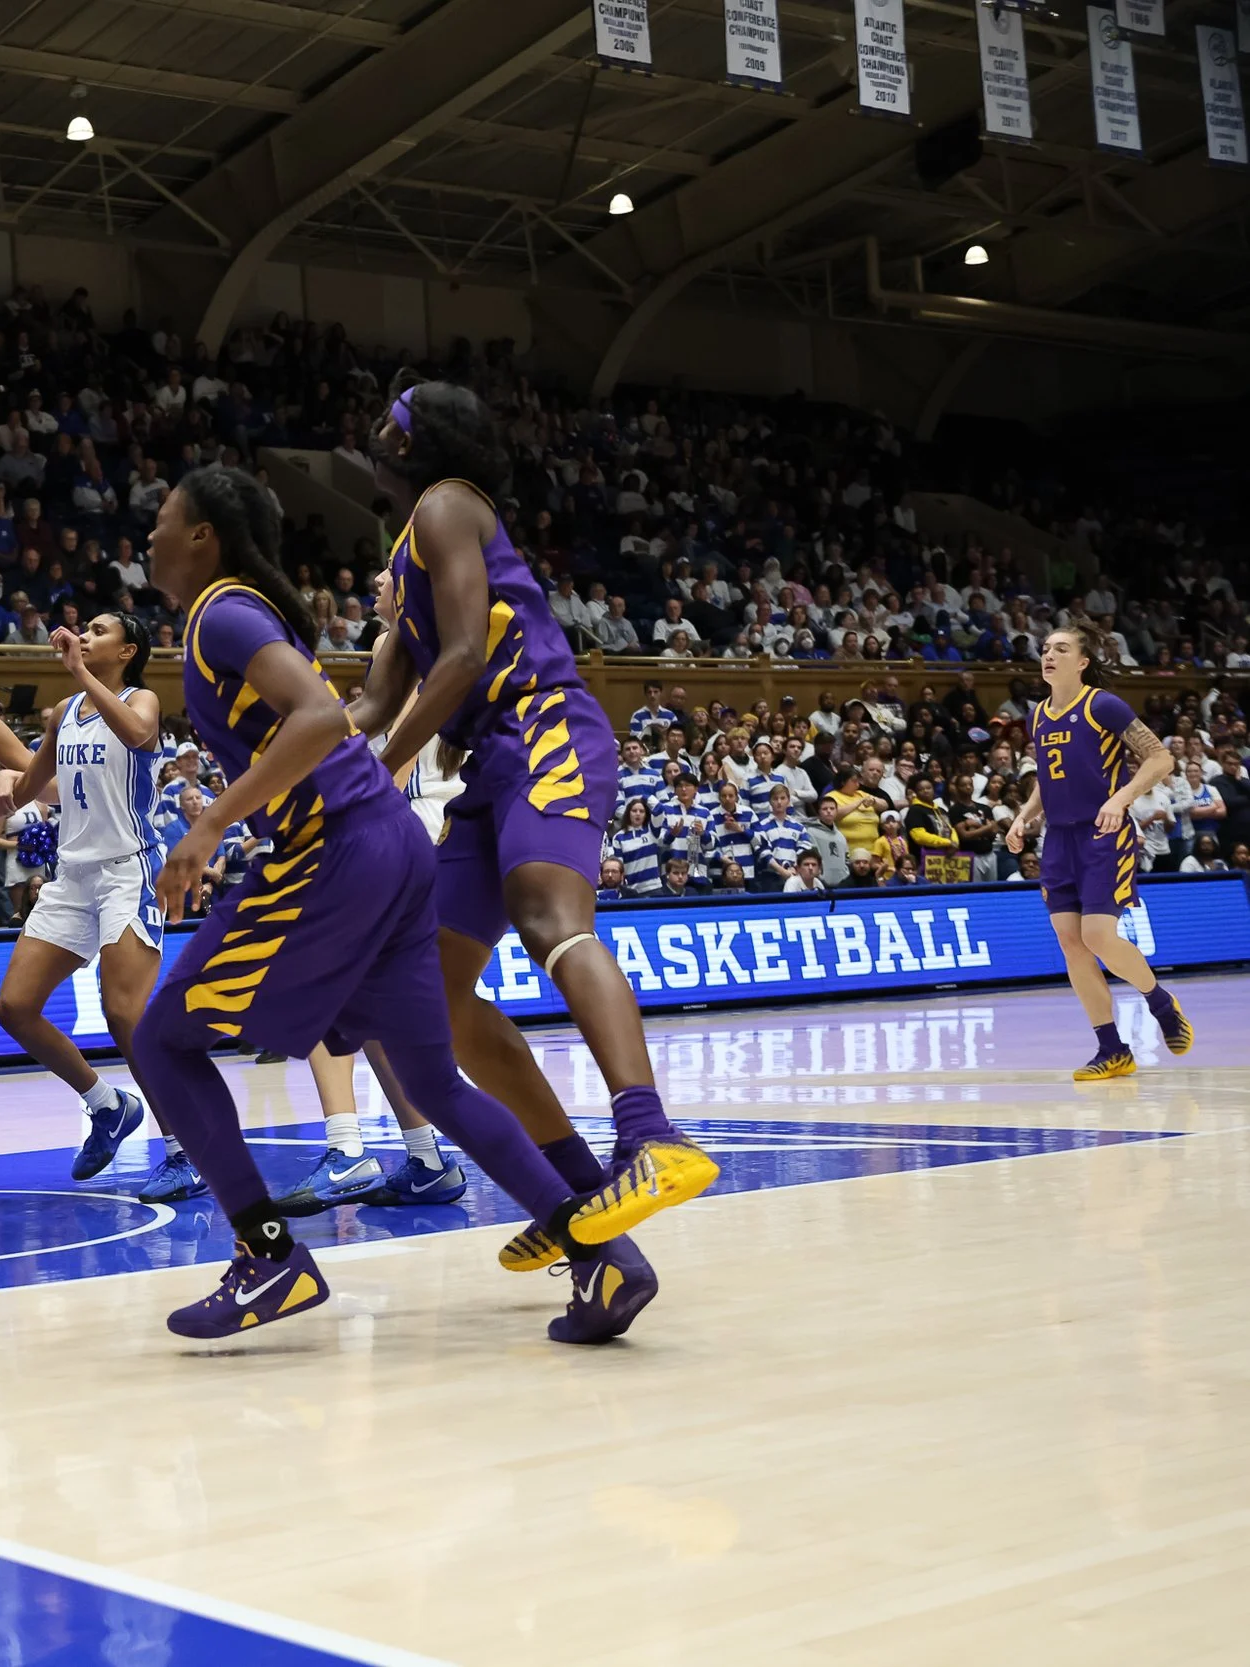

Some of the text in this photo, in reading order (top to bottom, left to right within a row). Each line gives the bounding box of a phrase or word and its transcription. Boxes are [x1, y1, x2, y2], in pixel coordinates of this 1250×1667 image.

[1041, 730, 1071, 747] LSU
[58, 743, 106, 766] DUKE
[1047, 748, 1066, 780] 2
[73, 771, 88, 810] 4
[146, 905, 162, 927] D
[608, 907, 992, 991] ASKETBALL
